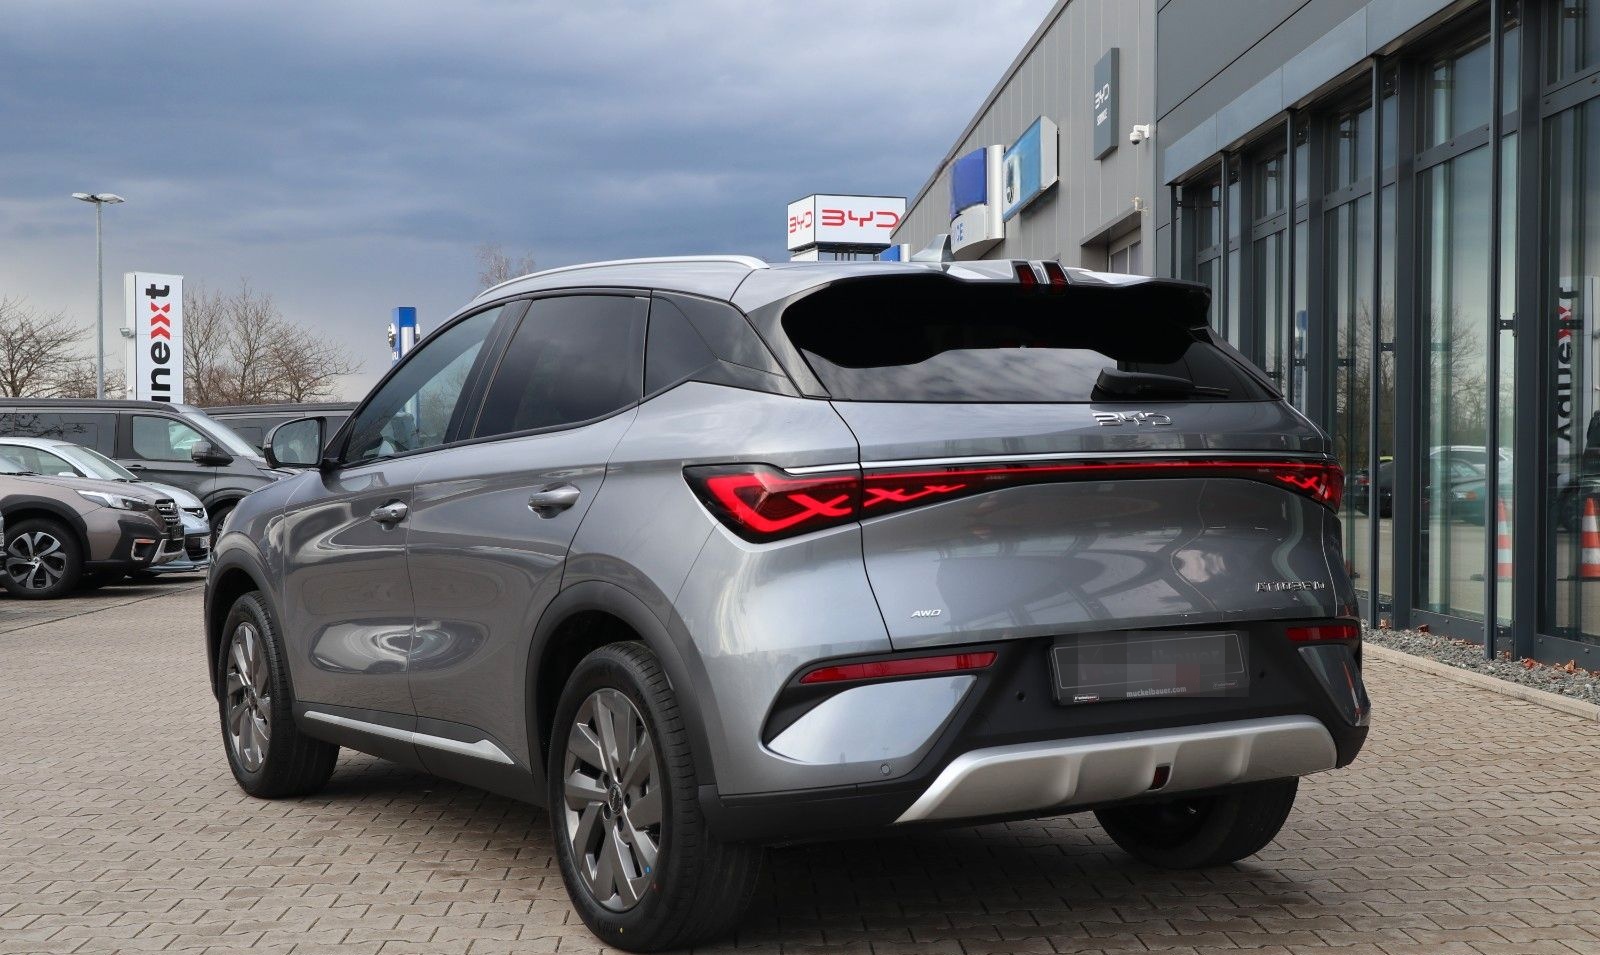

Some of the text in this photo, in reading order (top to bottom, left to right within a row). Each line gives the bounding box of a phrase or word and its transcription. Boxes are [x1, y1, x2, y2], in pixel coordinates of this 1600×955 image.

[789, 211, 813, 234] BYD
[822, 209, 900, 229] BYD
[1092, 412, 1173, 426] BYD
[910, 609, 942, 618] AWD
[1126, 686, 1187, 698] muckelbauer.com
